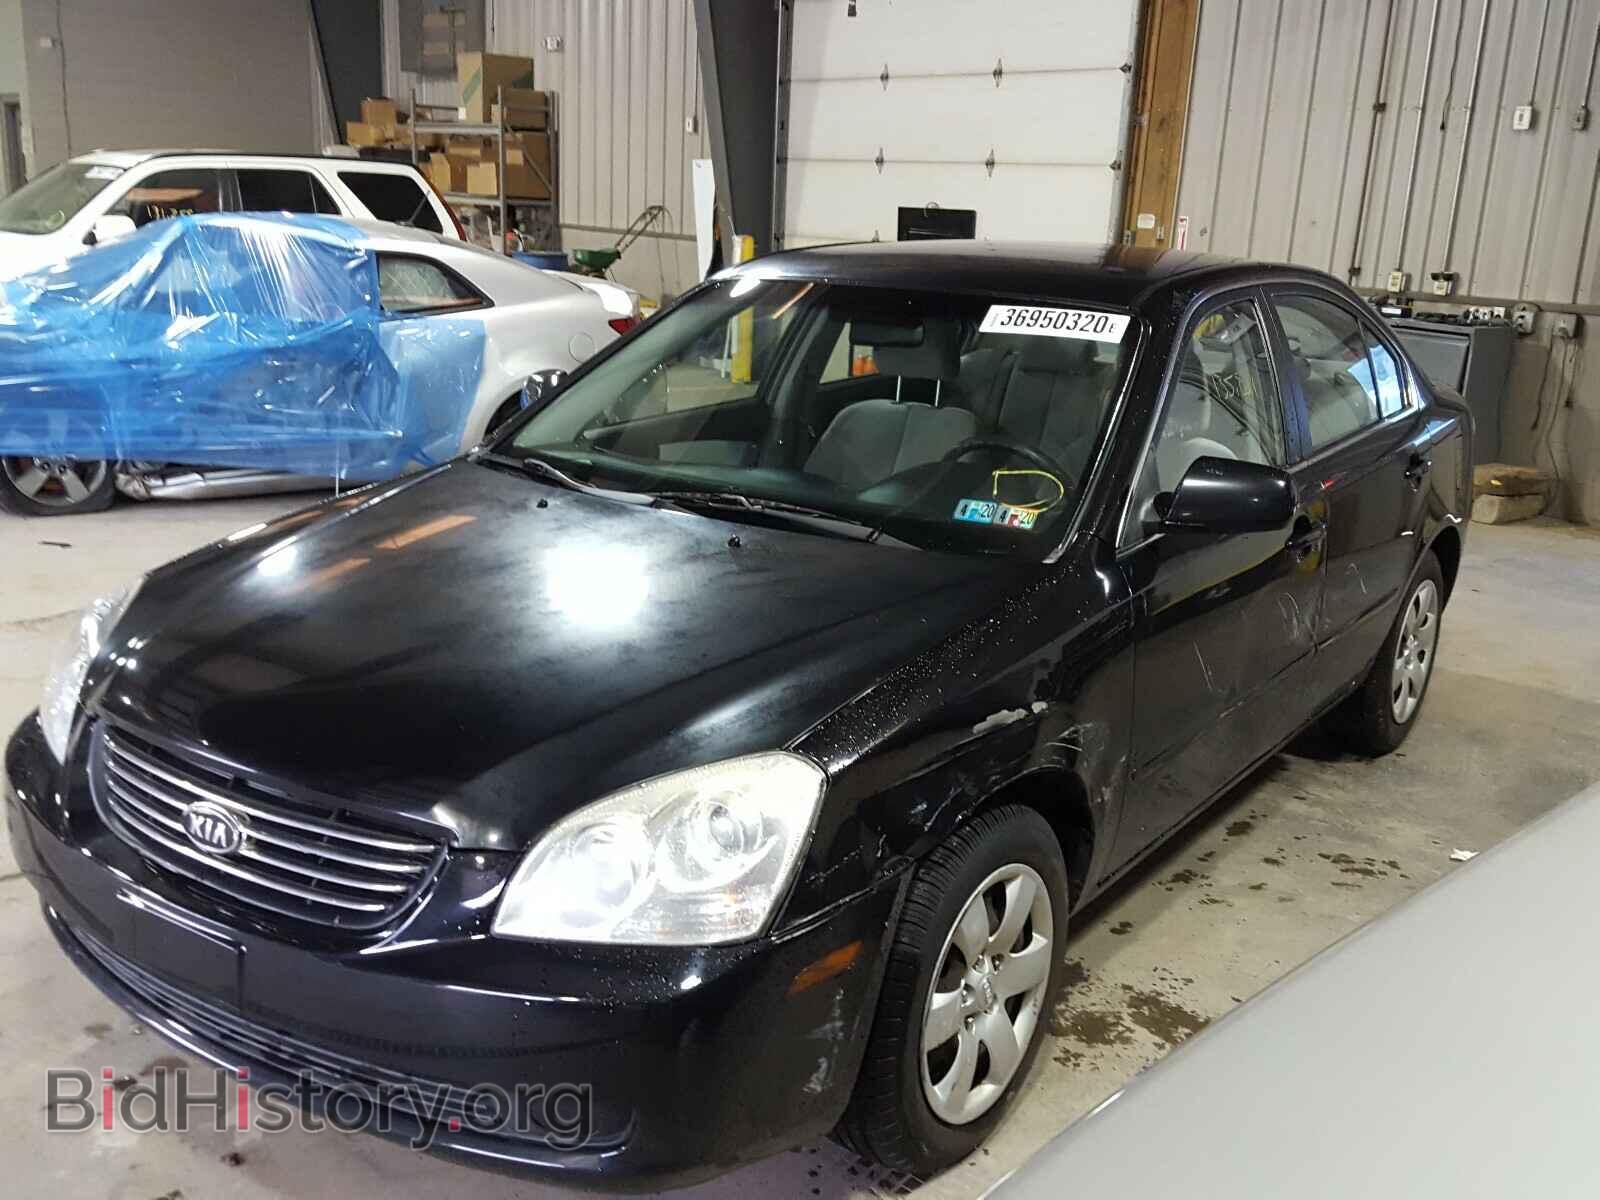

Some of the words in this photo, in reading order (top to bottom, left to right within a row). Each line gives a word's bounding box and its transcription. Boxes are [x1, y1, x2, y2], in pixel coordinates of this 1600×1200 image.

[1000, 308, 1109, 334] 36950320
[980, 504, 996, 518] 20
[189, 812, 227, 848] KIA
